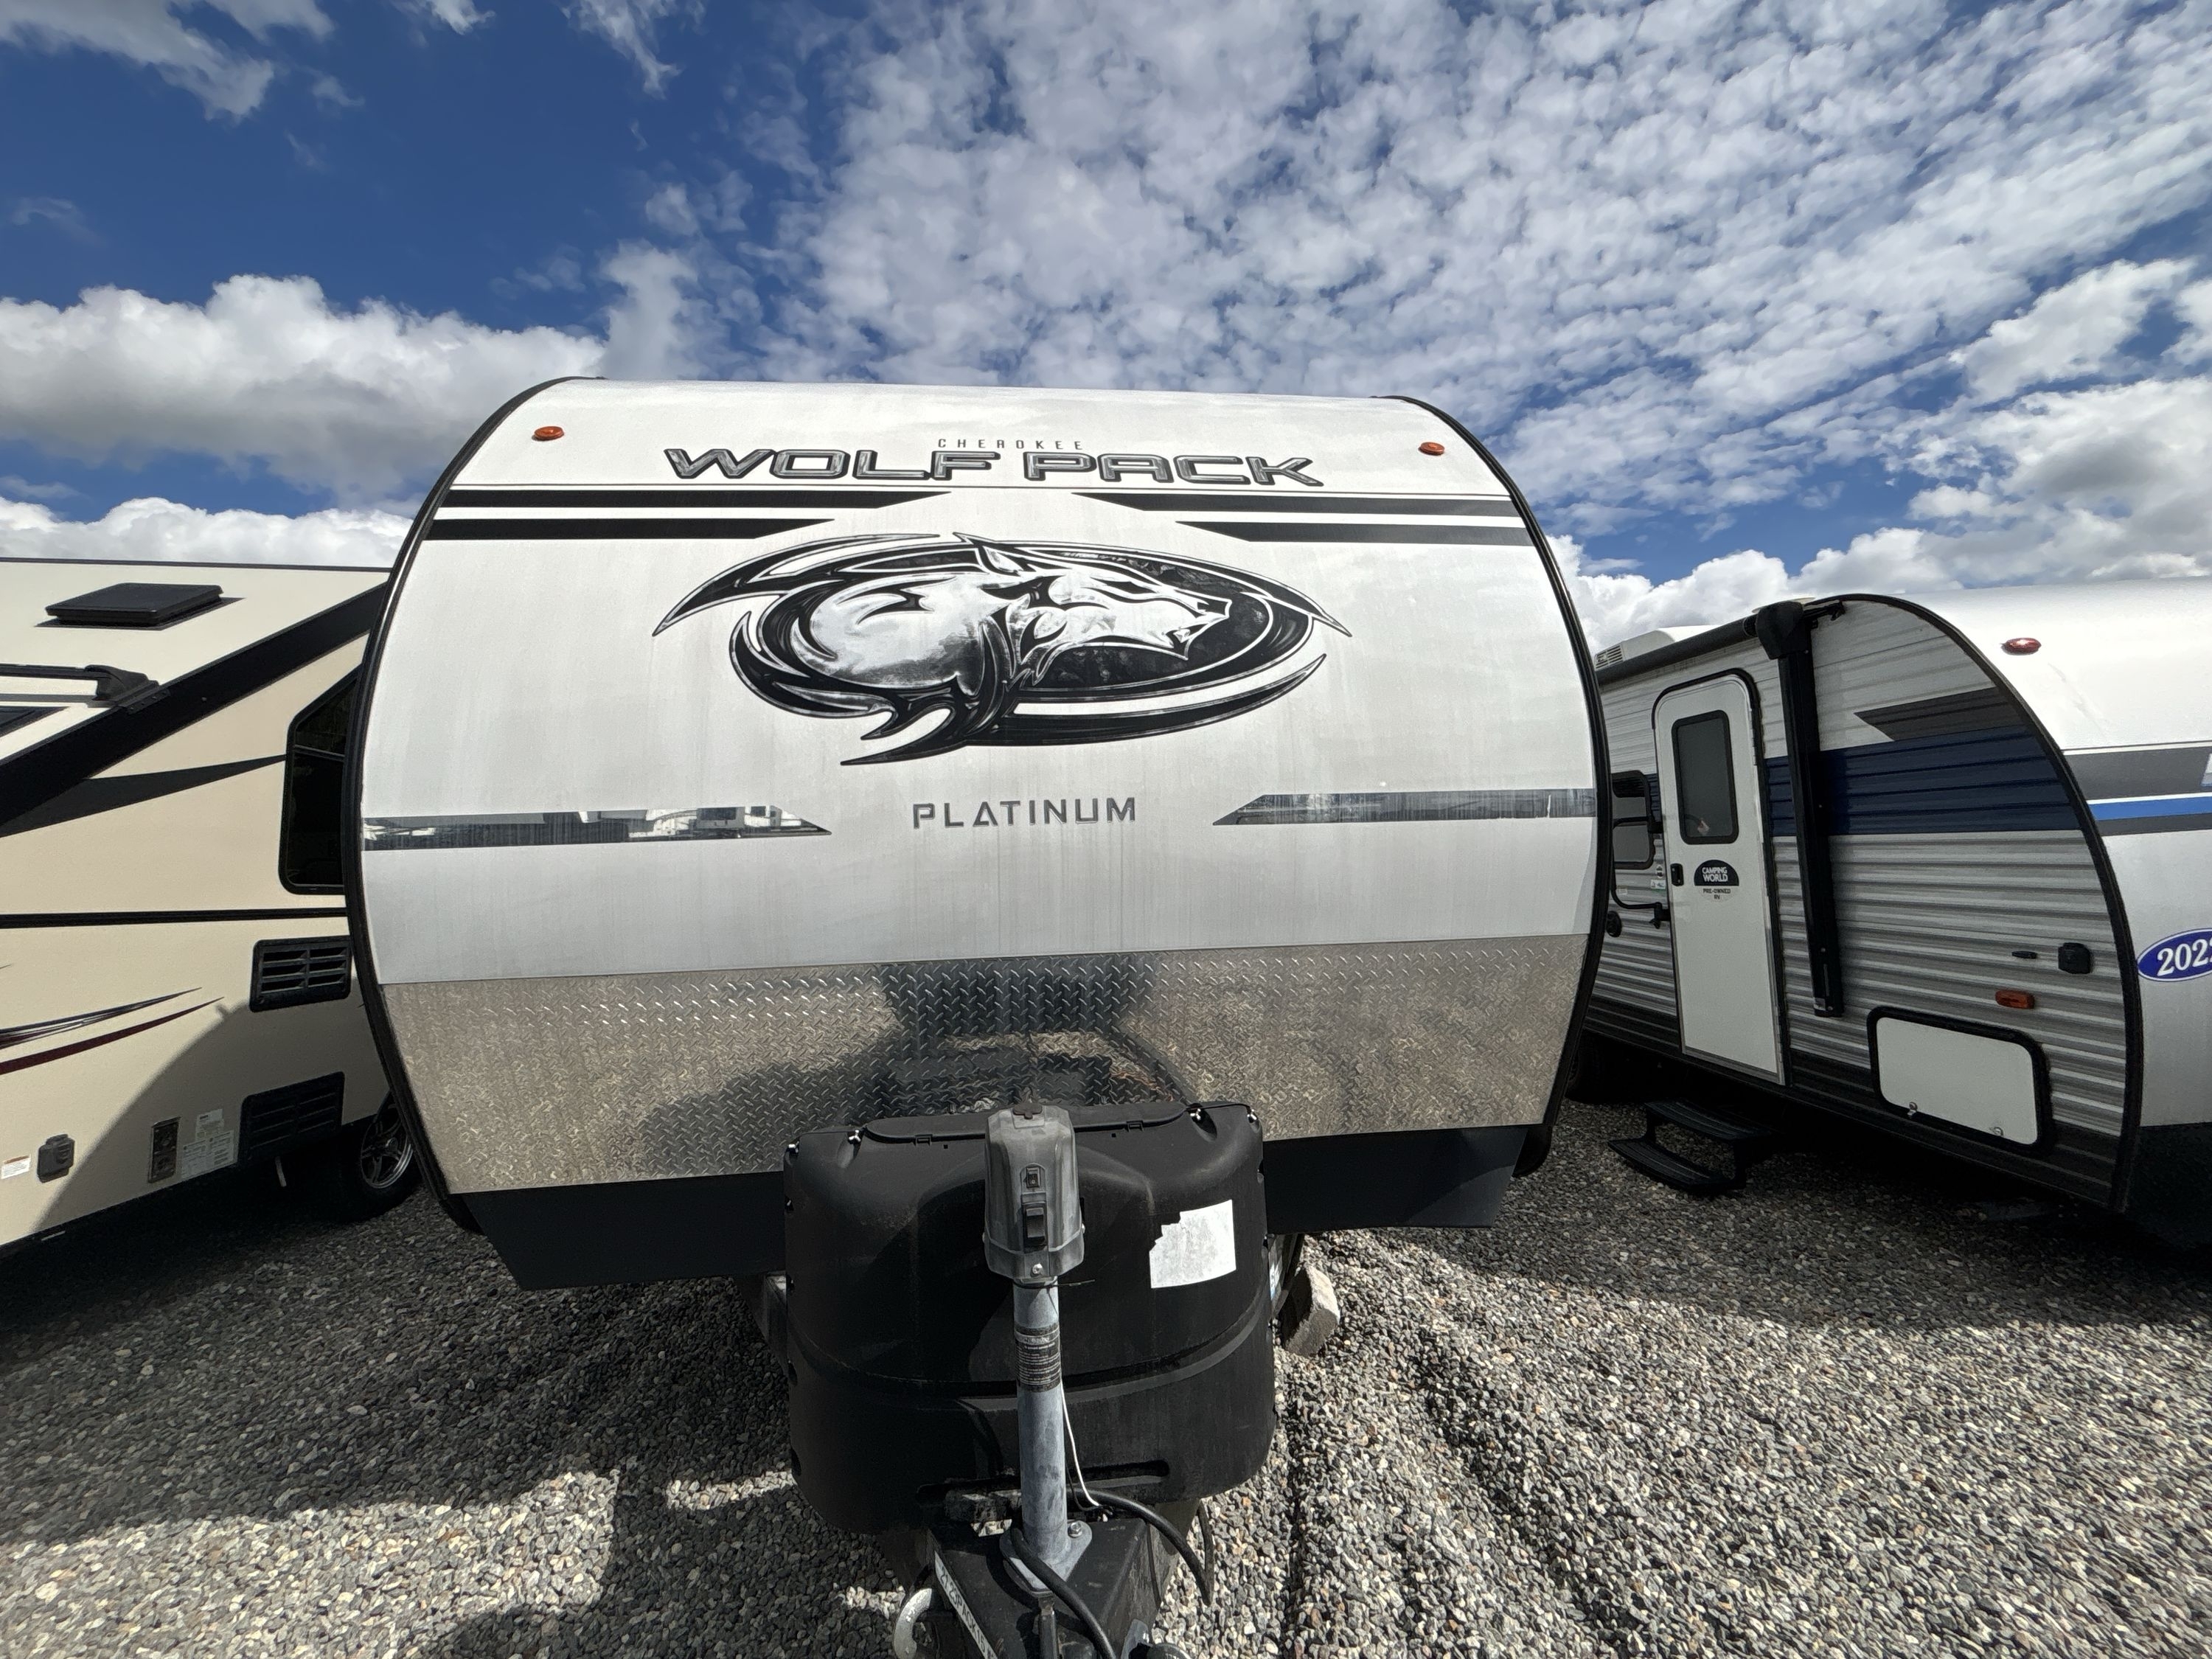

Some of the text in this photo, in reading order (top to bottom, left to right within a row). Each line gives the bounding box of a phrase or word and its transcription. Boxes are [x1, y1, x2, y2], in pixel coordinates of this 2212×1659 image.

[938, 439, 1083, 450] CHEROKEE
[664, 448, 1324, 487] WOLF PACK
[913, 797, 1135, 830] PLATINUM
[1703, 874, 1728, 882] WORLD
[2157, 936, 2212, 976] 202
